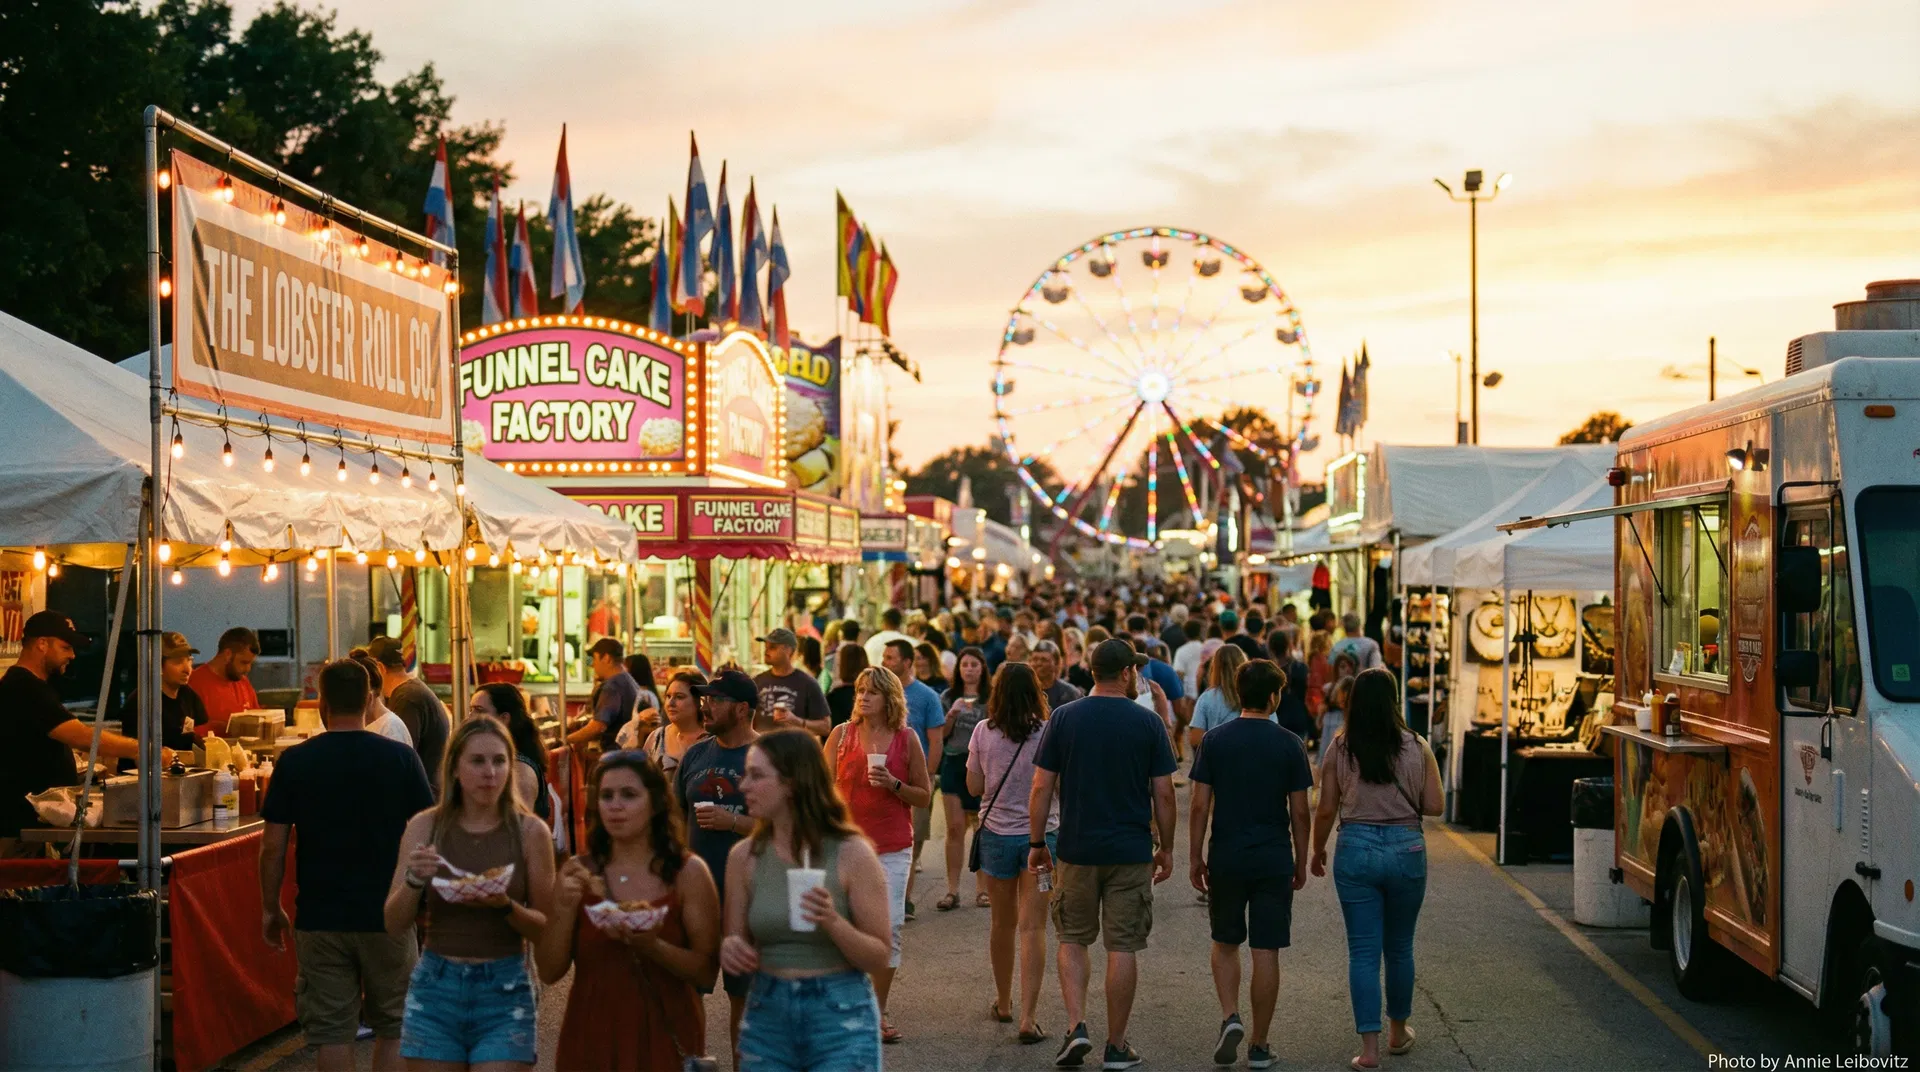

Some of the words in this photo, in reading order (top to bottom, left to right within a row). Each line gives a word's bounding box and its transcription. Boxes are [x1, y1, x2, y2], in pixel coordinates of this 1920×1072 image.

[203, 243, 254, 357] THE
[262, 265, 356, 383] LOBSTER
[361, 301, 406, 396] ROLL
[409, 317, 436, 402] CO.
[460, 343, 579, 407] FUNNEL
[586, 343, 671, 407] CAKE
[492, 401, 635, 441] FACTORY
[694, 501, 760, 517] FUNNEL
[763, 502, 792, 518] CAKE
[713, 518, 781, 533] FACTORY
